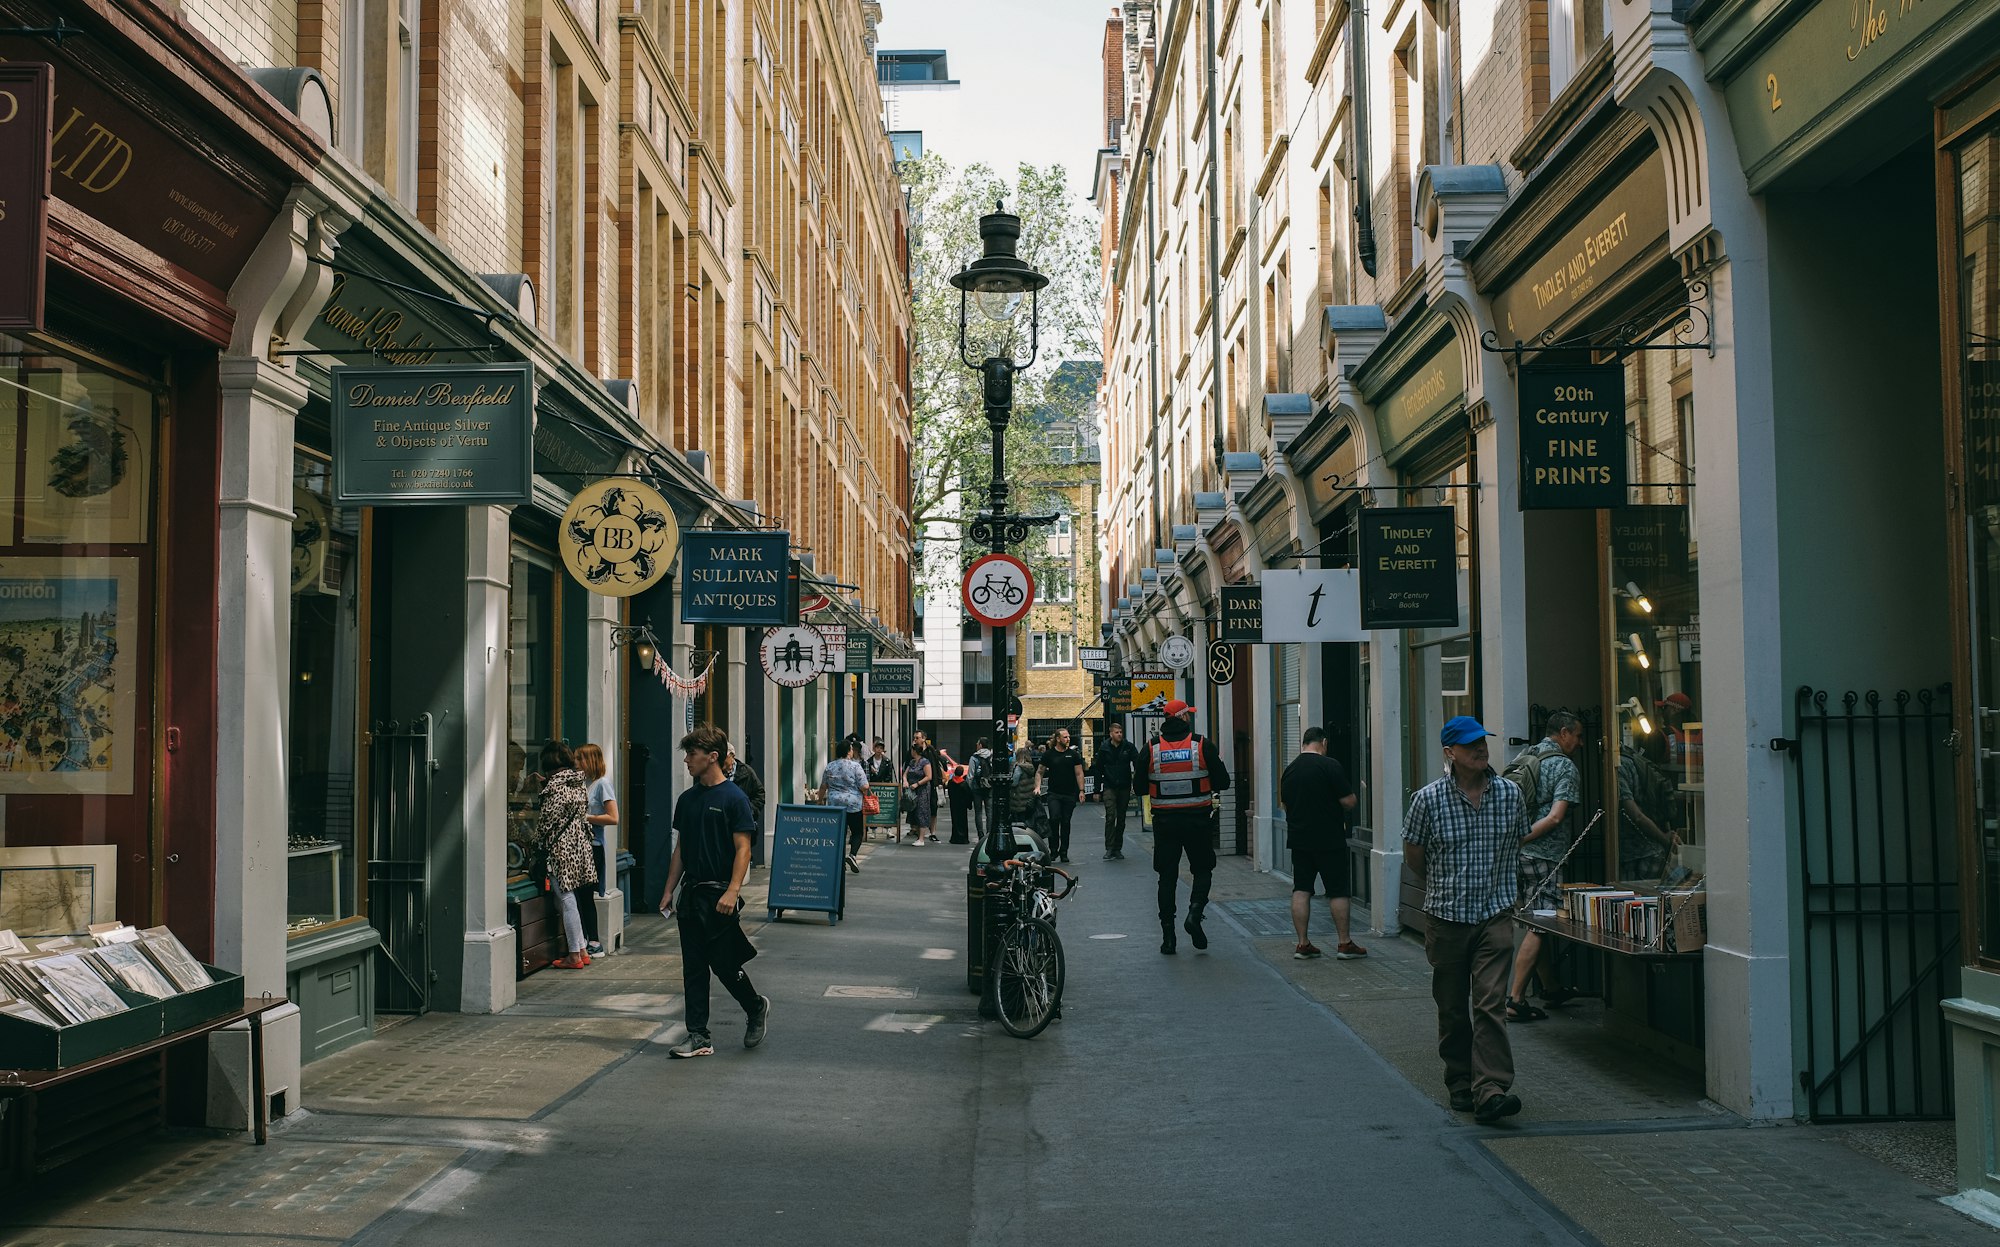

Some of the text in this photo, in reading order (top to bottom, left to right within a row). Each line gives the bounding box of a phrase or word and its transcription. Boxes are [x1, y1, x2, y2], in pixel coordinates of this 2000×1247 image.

[1766, 73, 1783, 114] 2
[51, 107, 134, 194] LTD
[162, 216, 185, 237] 0207
[193, 236, 216, 254] 3777
[1532, 212, 1629, 310] TINDLEY AND EVERETT
[1507, 312, 1514, 333] 4
[349, 382, 516, 413] Daniel Bexfield
[1553, 386, 1595, 402] 20th
[1535, 408, 1610, 426] Century
[373, 418, 491, 435] Fine Antique Silver
[376, 435, 489, 450] & Objects of Vertu
[1548, 439, 1598, 458] FINE
[391, 468, 473, 478] Tel: 020 7240 1766
[1535, 466, 1612, 485] PRINTS
[390, 479, 474, 489] www.bexfield.co.uk
[602, 527, 634, 550] BB
[1380, 525, 1433, 540] TINDLEY
[710, 547, 762, 561] MARK
[1394, 544, 1420, 554] AND
[1379, 557, 1437, 571] EVERETT
[692, 569, 779, 583] SULLIVAN
[692, 593, 777, 611] ANTIQUES
[1403, 591, 1430, 601] Century
[1306, 583, 1327, 628] t
[1398, 601, 1420, 609] Books
[1229, 618, 1262, 629] FINE
[1083, 650, 1105, 659] STREET
[760, 645, 821, 687] MEDAL COMPANY
[1085, 660, 1107, 670] BURGER
[879, 674, 912, 682] BOOKS
[995, 719, 1005, 732] 2
[1161, 750, 1190, 761] SECURITY
[783, 815, 839, 824] MARK SULLIVAN
[784, 837, 835, 847] ANTIQUES
